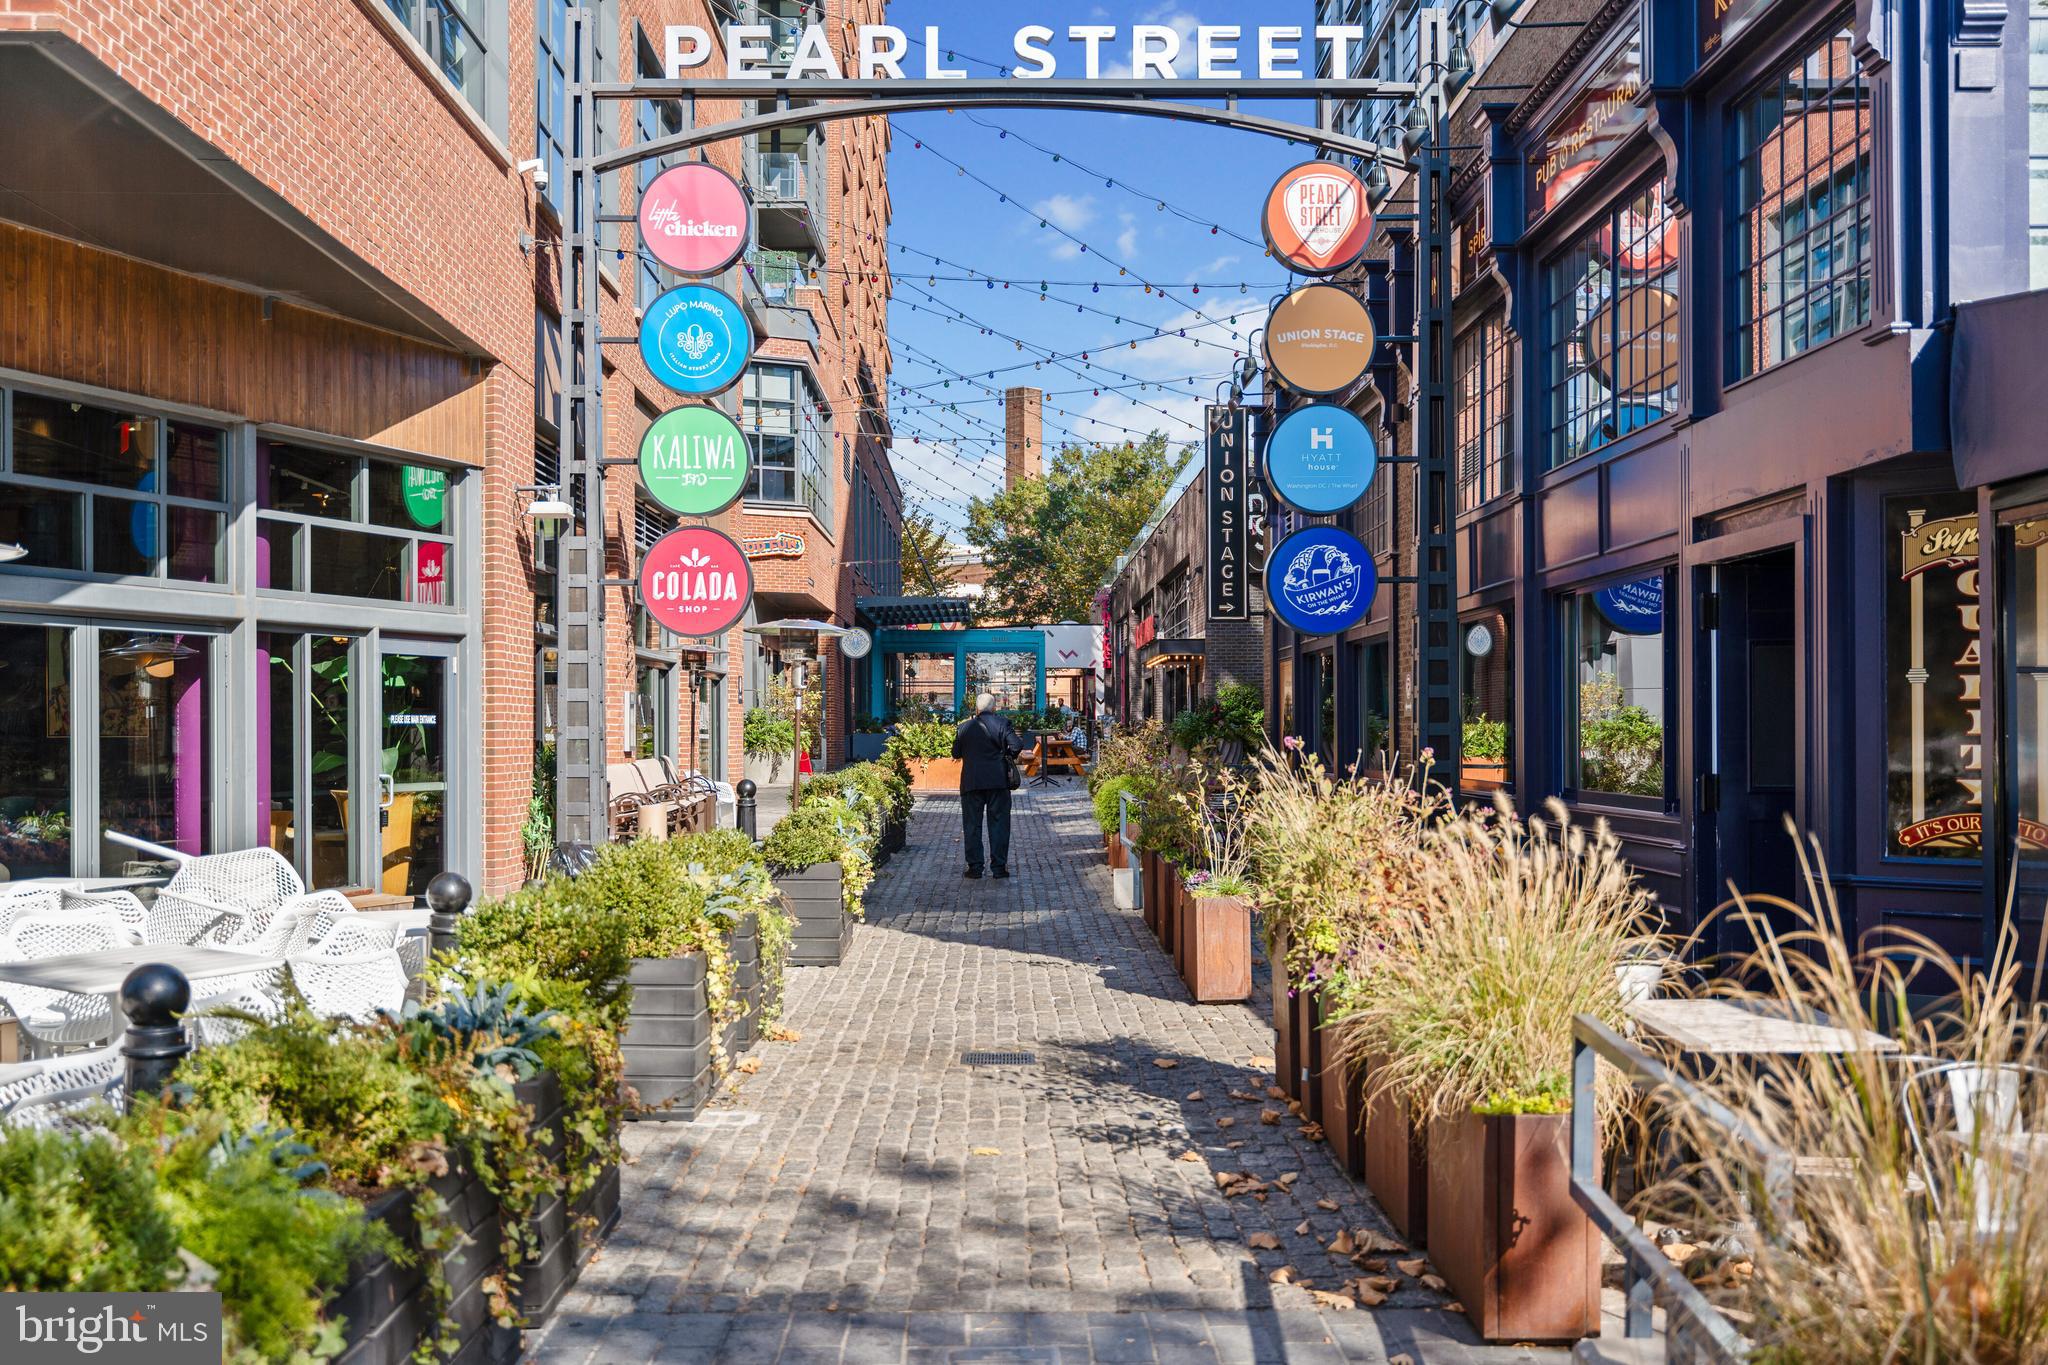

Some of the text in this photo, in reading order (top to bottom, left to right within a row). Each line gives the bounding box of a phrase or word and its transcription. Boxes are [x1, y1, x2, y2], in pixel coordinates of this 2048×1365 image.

[665, 25, 1364, 79] PEARL STREET
[1535, 154, 1556, 191] PUB
[1571, 71, 1641, 157] RESTAURAN
[1300, 184, 1342, 204] PEARL
[1300, 206, 1342, 226] STREET
[664, 219, 738, 237] chicken
[1468, 226, 1486, 258] SPIR
[665, 301, 724, 319] LUPO MARINO
[1277, 328, 1365, 343] UNION STAGE
[669, 352, 688, 370] ITALIAN
[653, 434, 736, 470] KALIWA
[1301, 453, 1342, 462] HYATT
[1308, 463, 1336, 471] house
[1220, 511, 1235, 597] STAGE
[652, 571, 738, 600] COLADA
[1296, 578, 1352, 605] KIRWAN'S
[1329, 591, 1348, 603] WHARF
[678, 605, 708, 613] SHOP
[390, 714, 404, 724] PLEASE
[1915, 821, 1944, 839] IT'S
[1947, 816, 1982, 831] OUR
